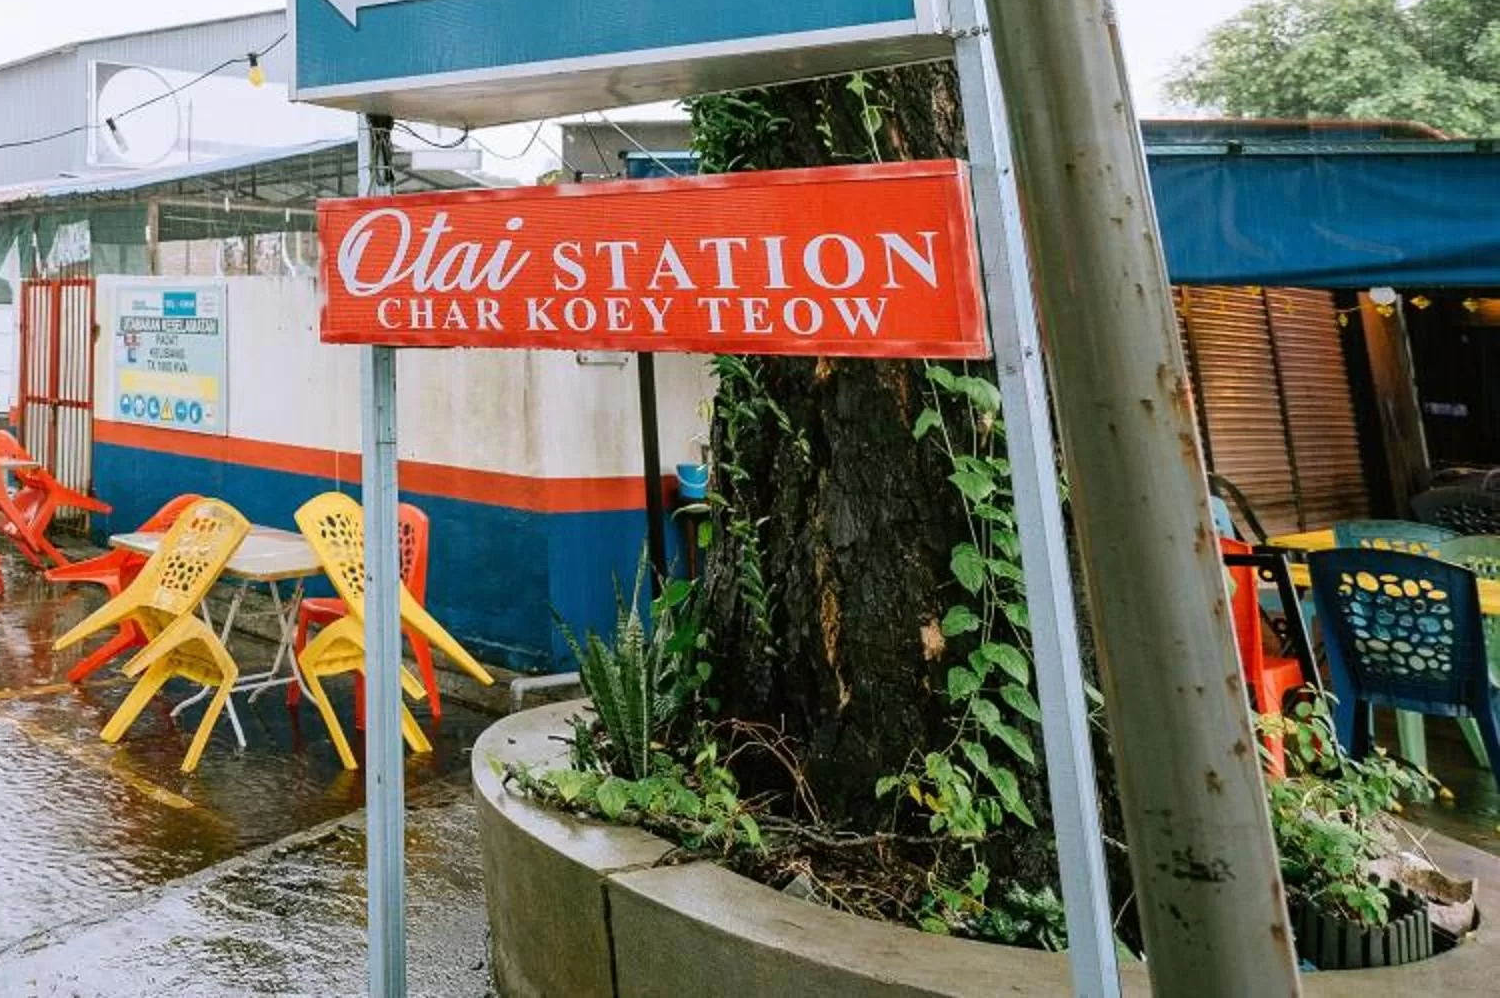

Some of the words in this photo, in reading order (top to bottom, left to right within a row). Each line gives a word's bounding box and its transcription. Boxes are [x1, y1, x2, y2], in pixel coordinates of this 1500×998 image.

[337, 207, 532, 298] Otai
[552, 230, 941, 293] STATION
[376, 297, 504, 331] CHAR
[525, 297, 676, 333] KOEY
[697, 297, 889, 336] TEOW
